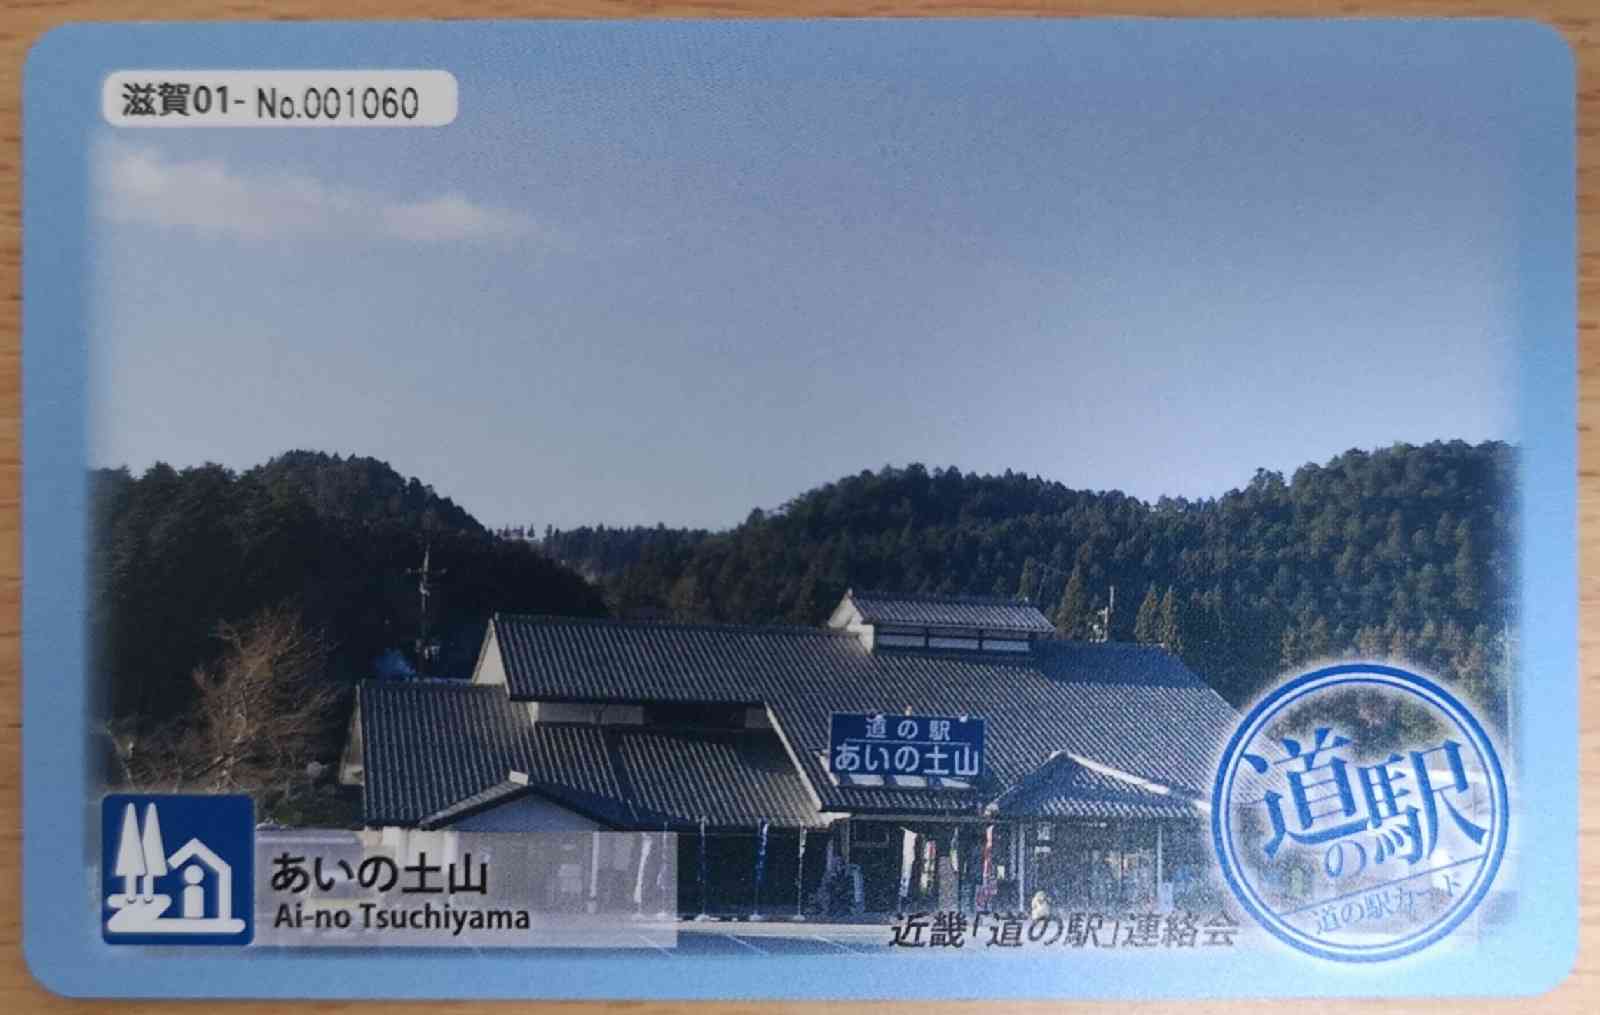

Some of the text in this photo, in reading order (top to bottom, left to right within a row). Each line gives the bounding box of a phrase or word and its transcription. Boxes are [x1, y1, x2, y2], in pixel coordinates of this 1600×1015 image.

[257, 86, 420, 120] No.001060
[865, 714, 951, 742] 道の駅
[834, 742, 980, 777] あいの土山
[270, 852, 489, 895] あいの土山
[273, 902, 531, 935] Ai-no Tsuchiyama
[888, 909, 1240, 949] 近畿「道の駅」連絡会
